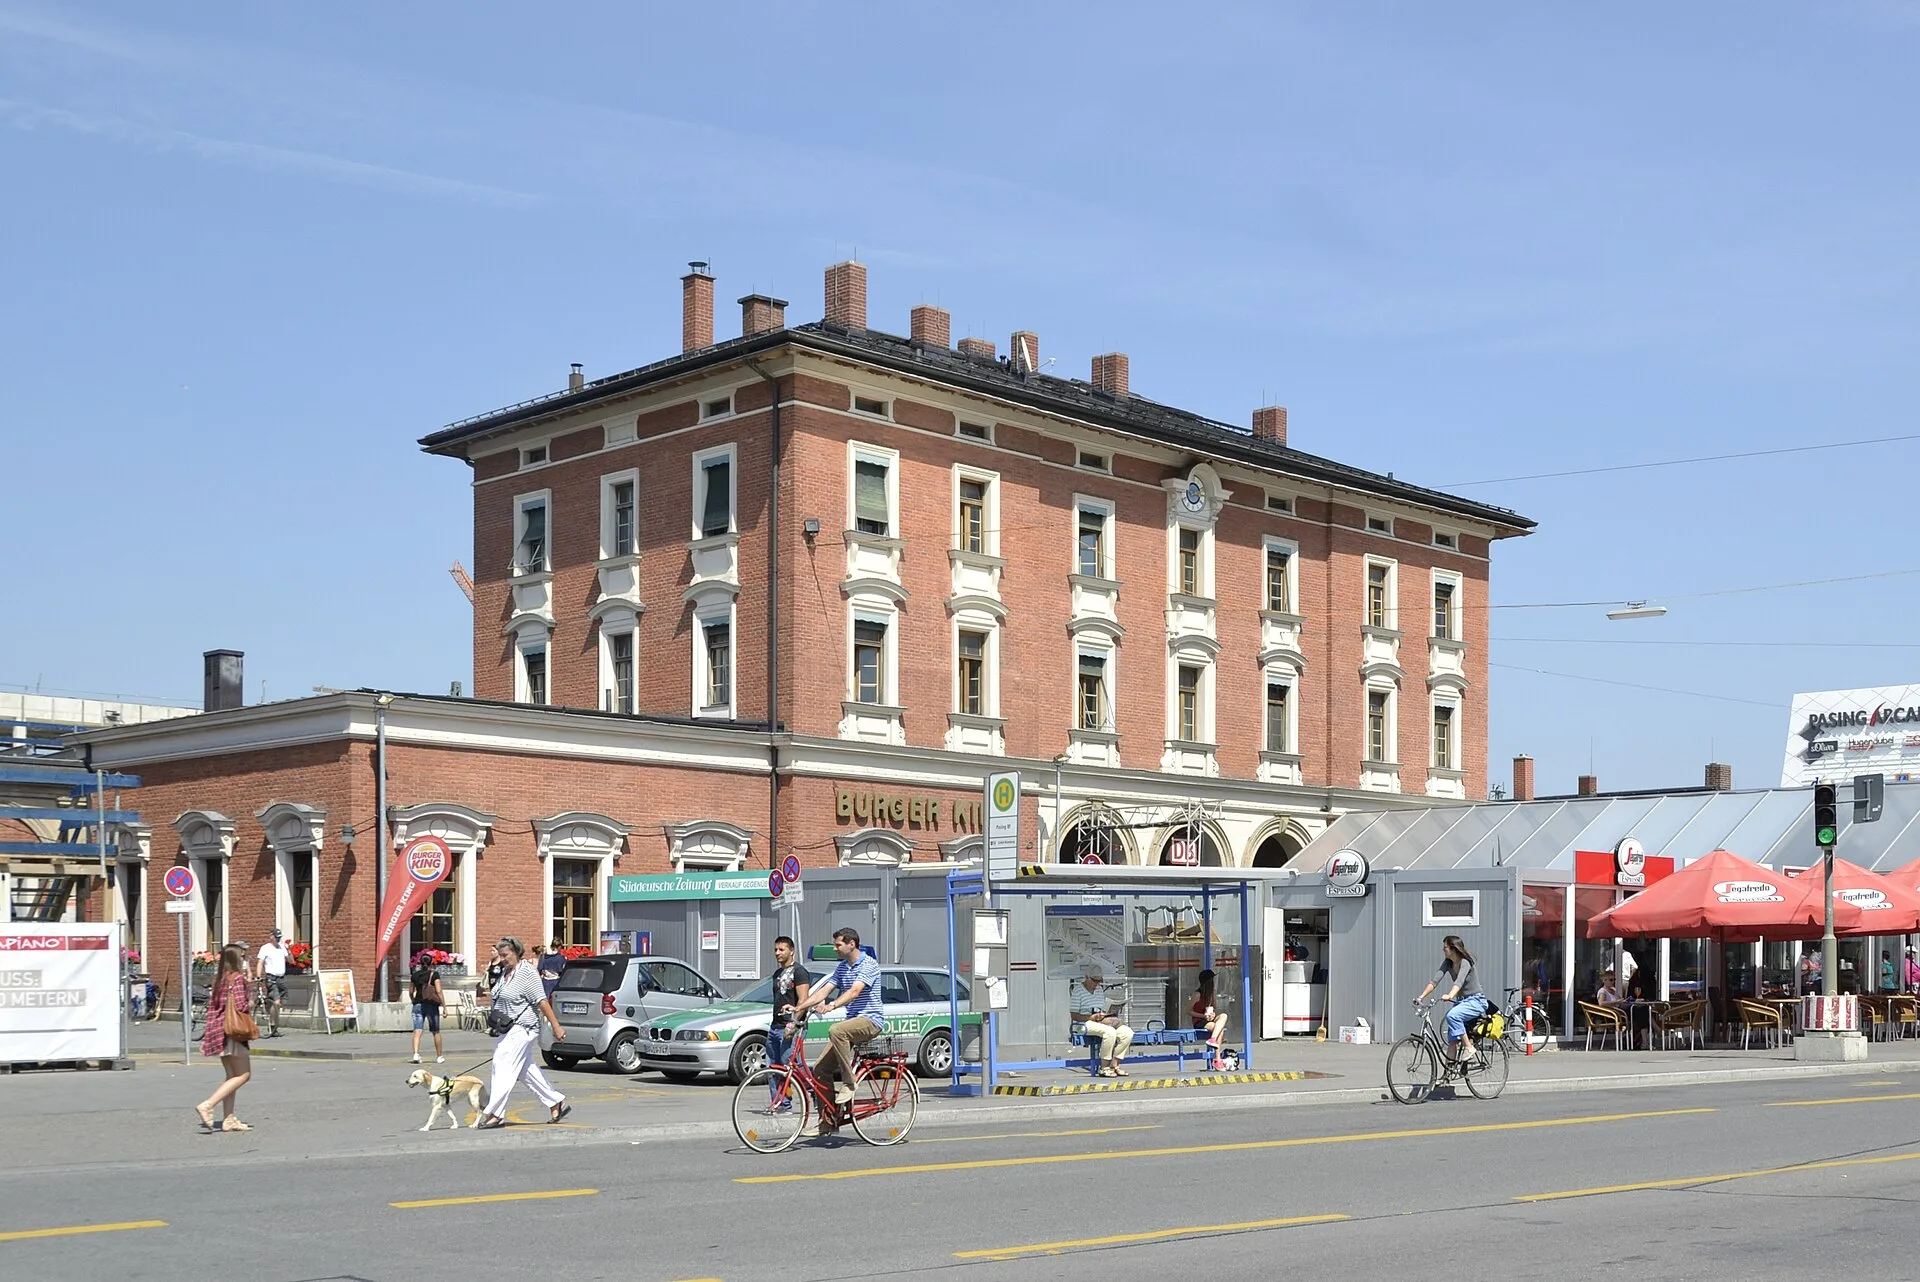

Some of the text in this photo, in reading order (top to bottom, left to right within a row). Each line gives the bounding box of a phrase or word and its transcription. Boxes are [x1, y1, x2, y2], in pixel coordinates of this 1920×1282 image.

[1809, 701, 1920, 728] PASING ARCA
[1848, 736, 1894, 748] Hugendubel
[837, 789, 943, 823] BURGER
[411, 851, 442, 860] BURGER
[411, 858, 441, 870] KING
[618, 876, 713, 895] Süddeutsche Zeitung
[718, 880, 742, 889] VERKAUF
[1721, 883, 1770, 894] Segafredo
[381, 880, 416, 942] BURGER KING
[11, 991, 84, 1006] METERN.
